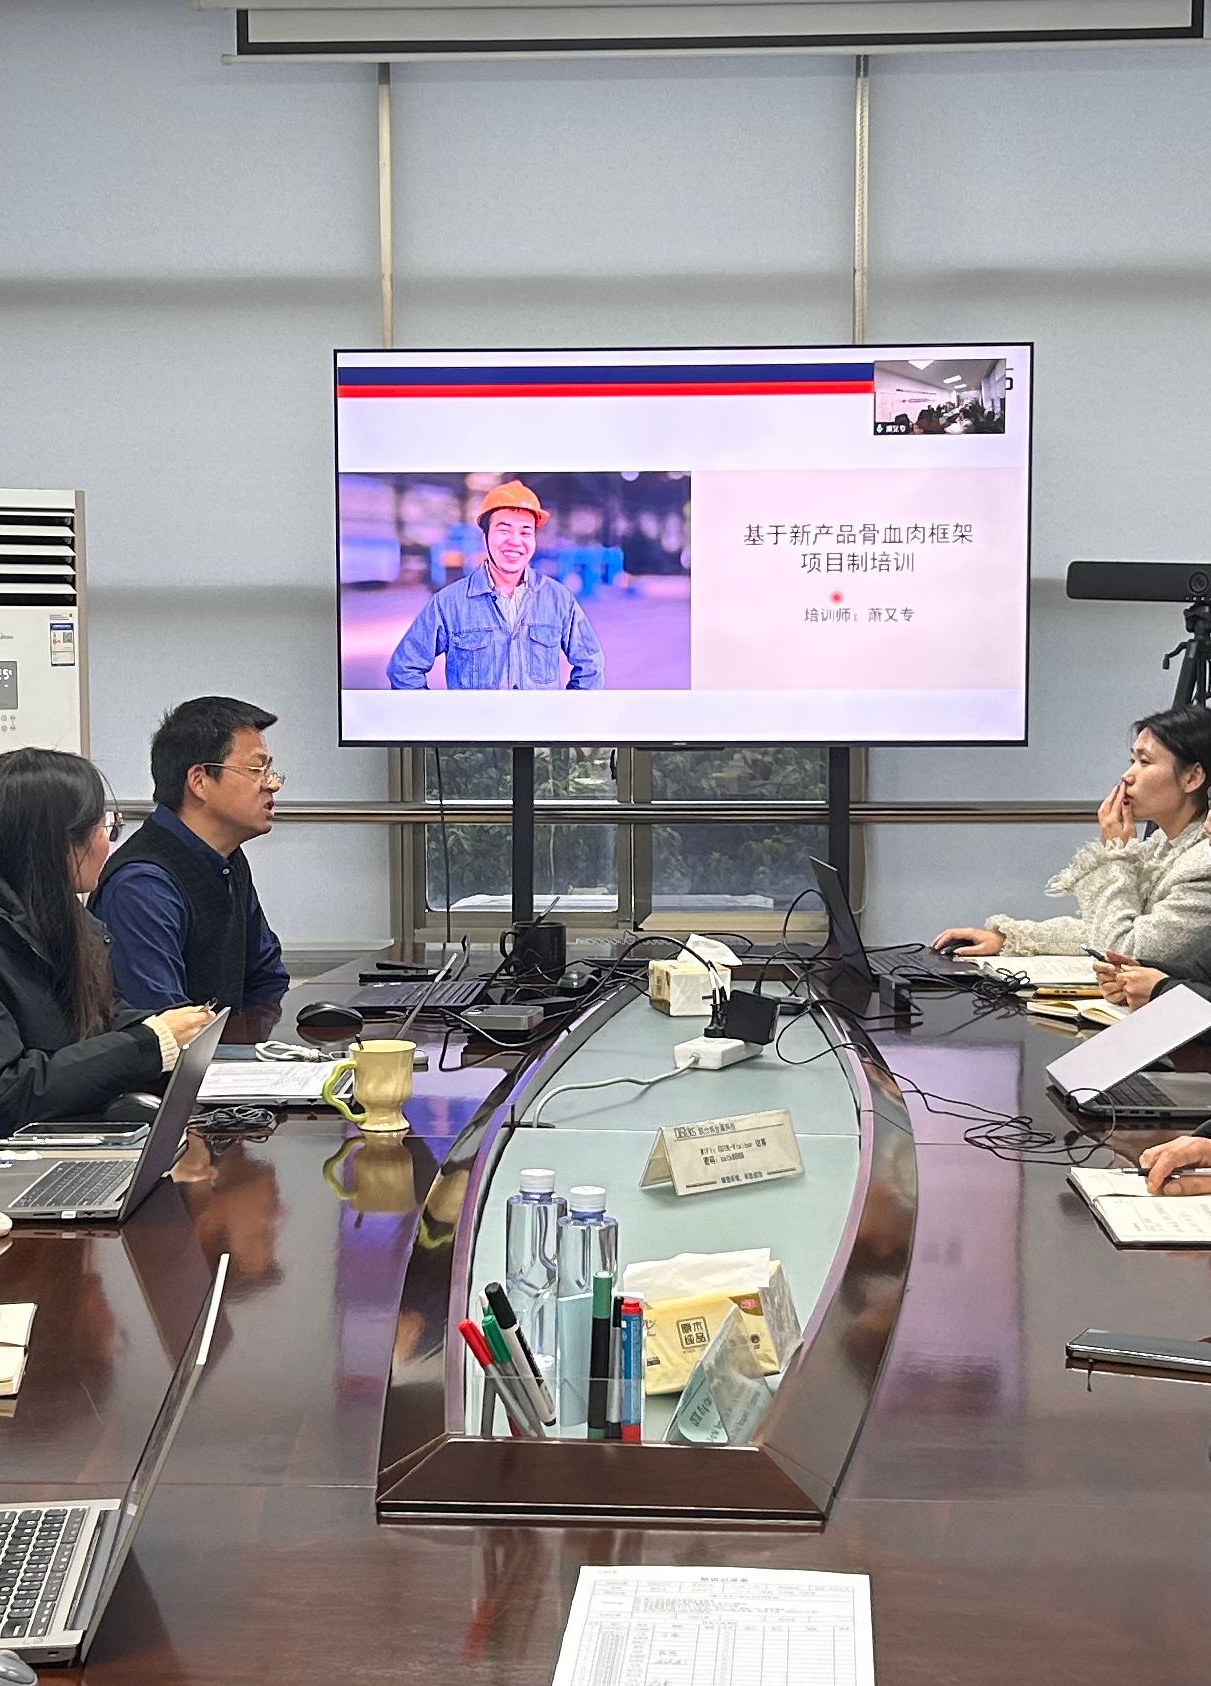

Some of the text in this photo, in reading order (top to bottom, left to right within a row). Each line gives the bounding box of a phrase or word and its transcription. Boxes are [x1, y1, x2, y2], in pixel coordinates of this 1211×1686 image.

[743, 523, 974, 546] 基于新产品骨血肉框架
[800, 551, 915, 574] 项目制培训
